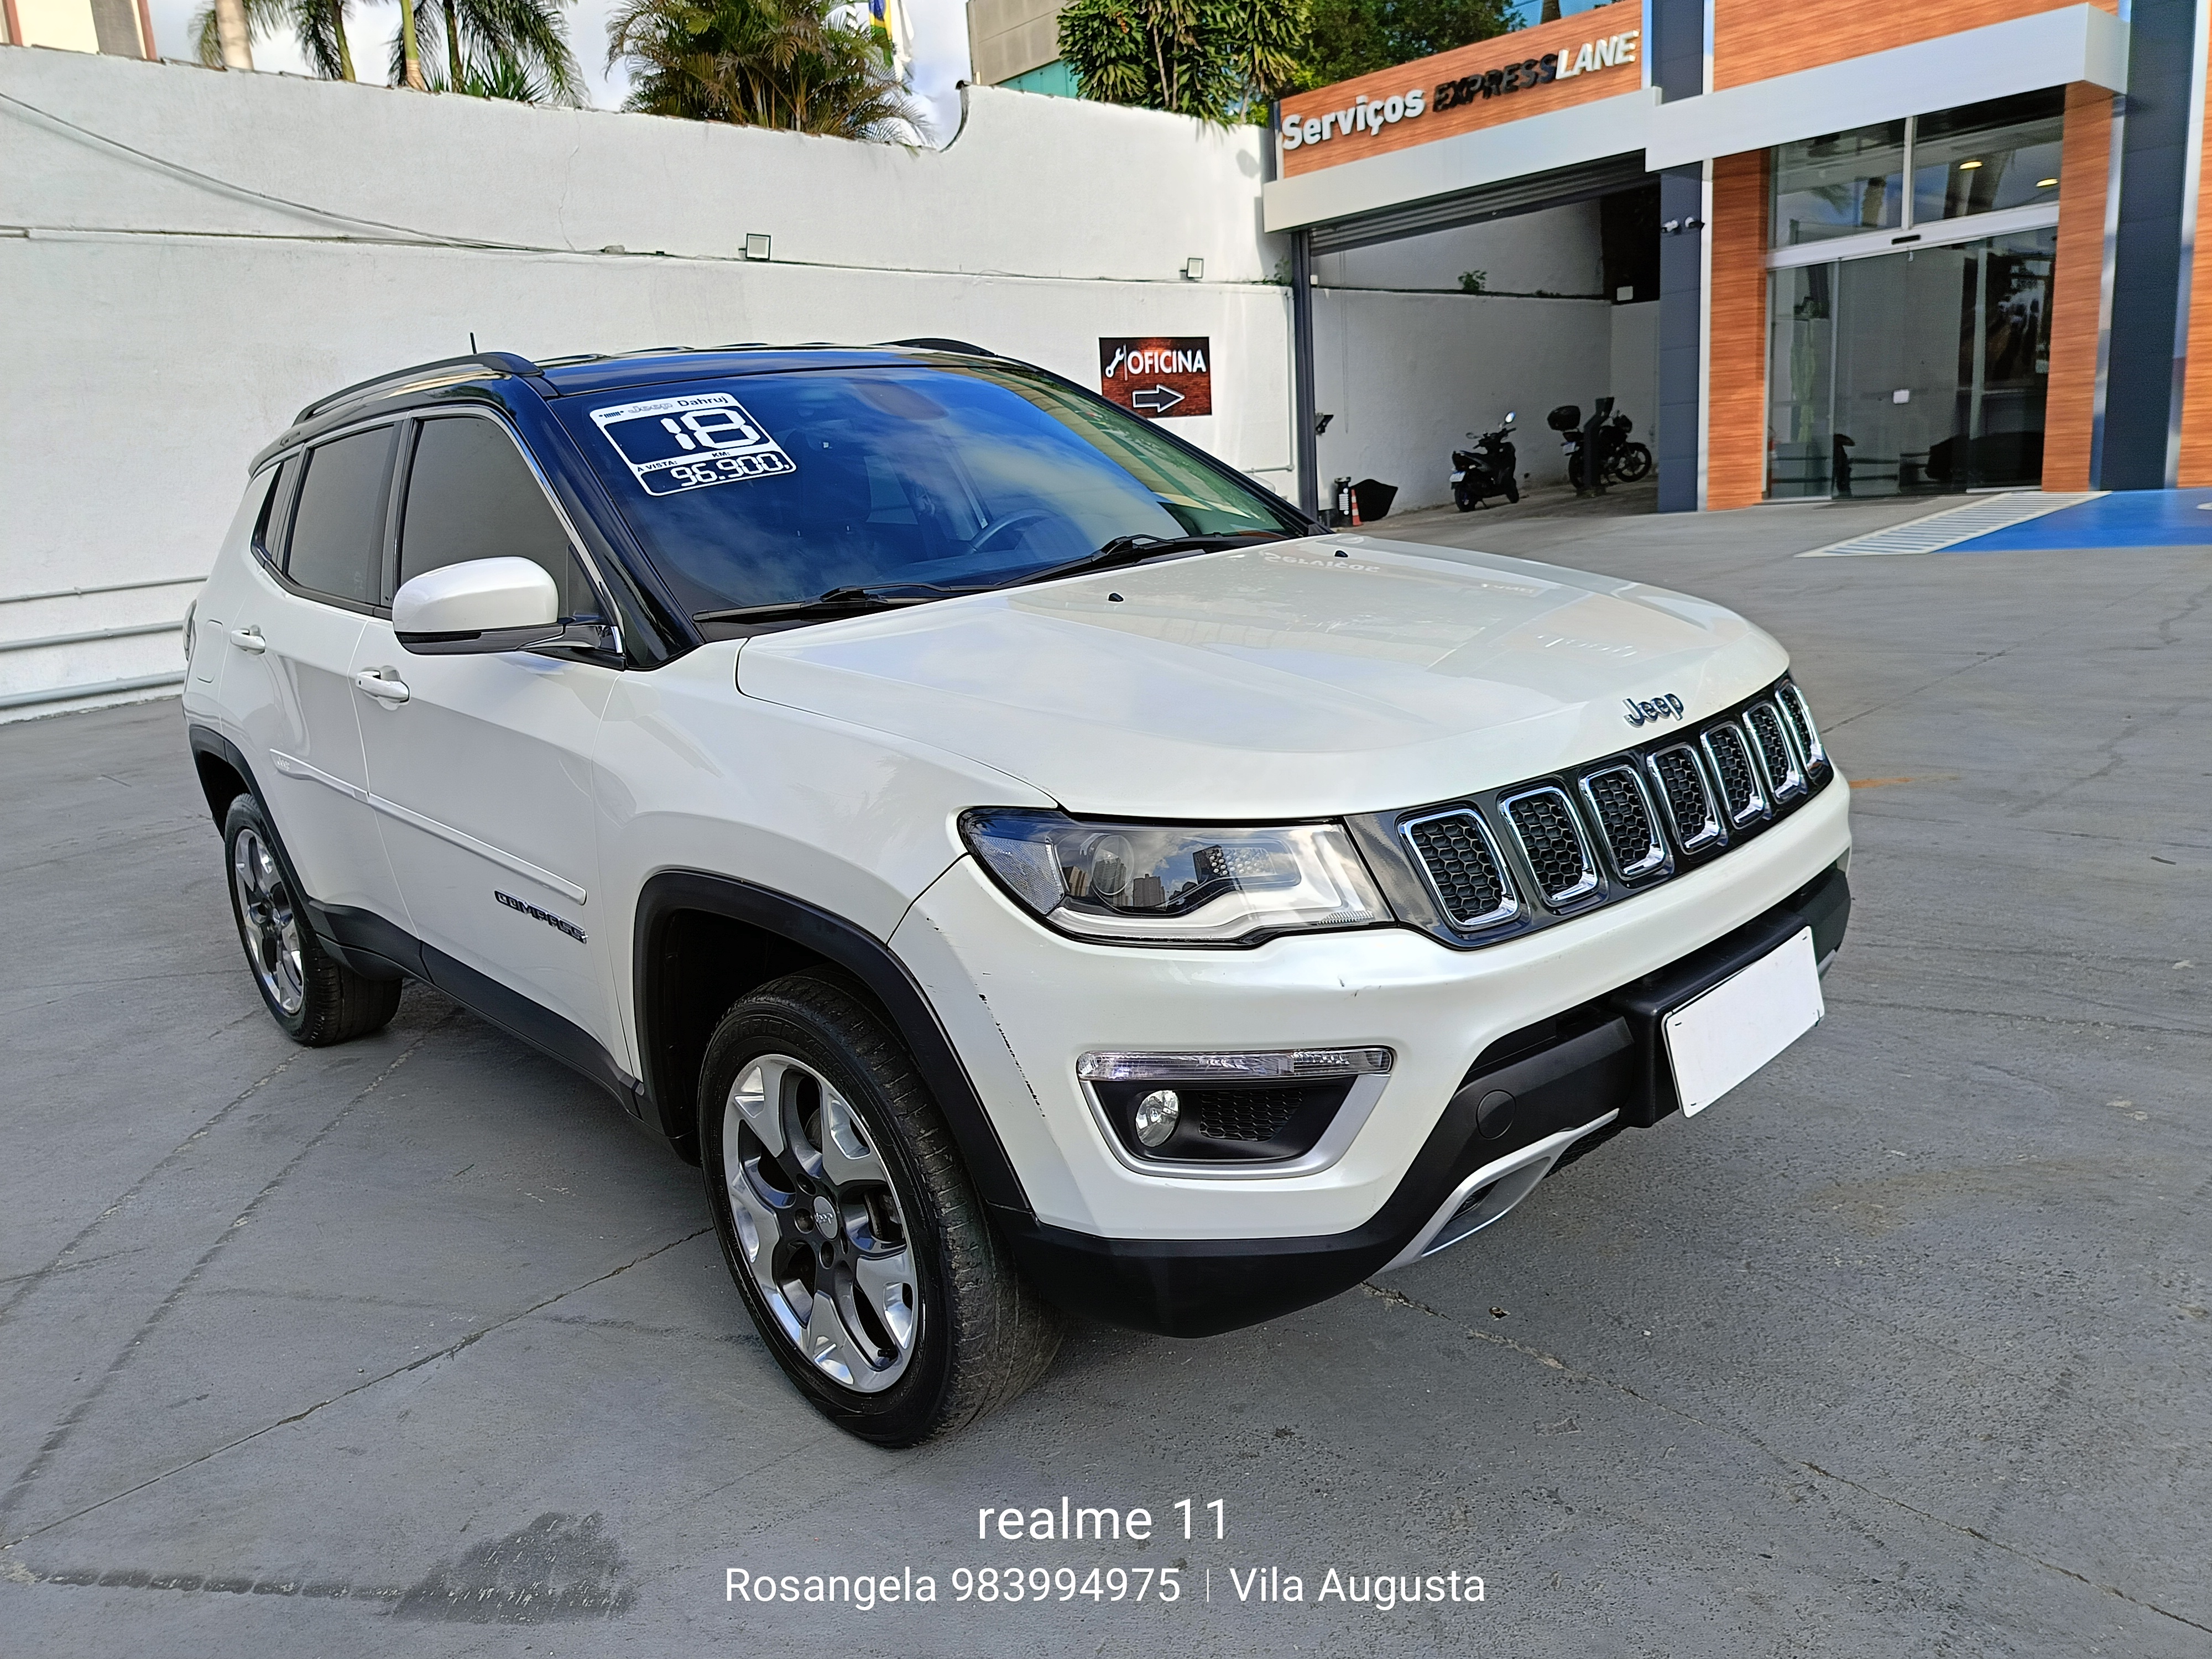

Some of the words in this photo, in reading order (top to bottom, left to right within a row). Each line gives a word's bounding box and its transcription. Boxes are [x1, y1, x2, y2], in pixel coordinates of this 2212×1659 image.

[1282, 89, 1426, 150] Serviços
[1128, 349, 1207, 374] OFICINA
[628, 403, 673, 414] Jeep
[677, 396, 728, 407] Dahruj
[660, 409, 761, 450] 18
[645, 461, 677, 469] VISTA:
[1622, 693, 1684, 728] Jeep
[494, 889, 588, 945] COMPASS
